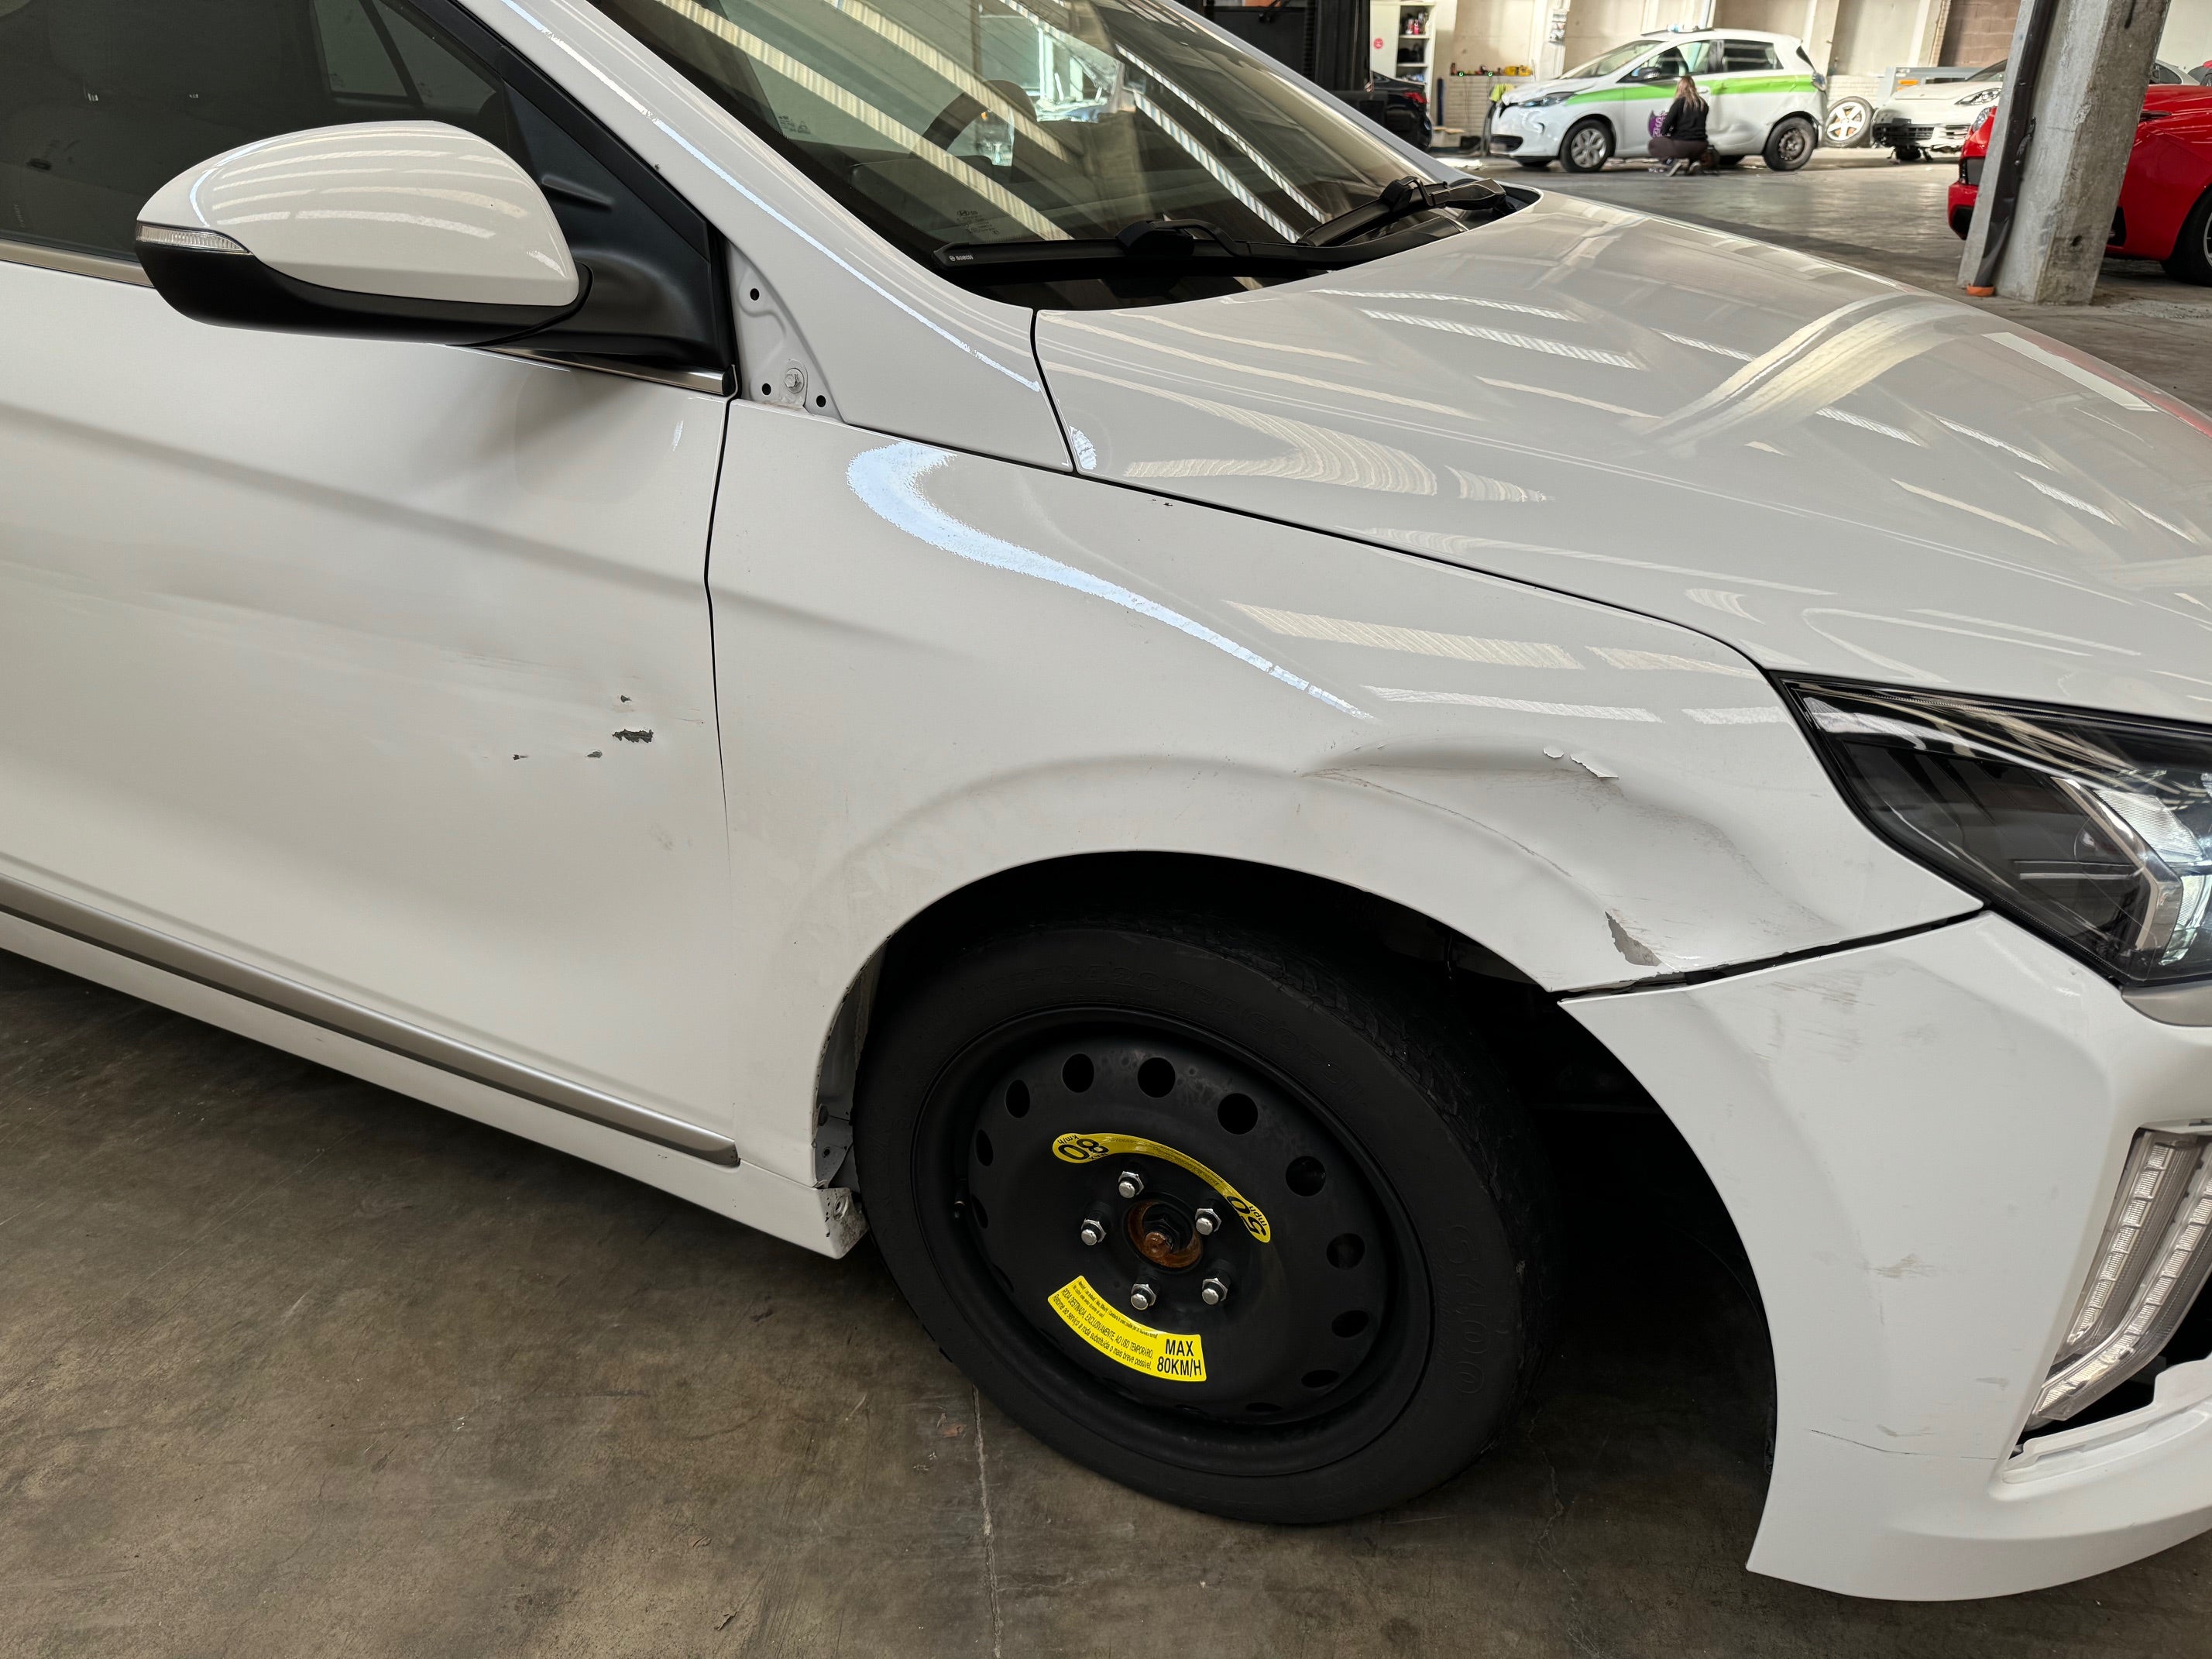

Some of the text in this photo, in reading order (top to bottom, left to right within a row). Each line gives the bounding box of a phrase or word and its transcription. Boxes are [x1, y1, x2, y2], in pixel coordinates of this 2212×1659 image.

[1057, 1134, 1079, 1145] km/h
[1058, 1138, 1109, 1161] 80
[1227, 1196, 1267, 1236] 50
[1249, 1205, 1268, 1227] mph
[1081, 1326, 1091, 1336] roda
[1113, 1348, 1123, 1357] mais
[1122, 1352, 1134, 1363] breve
[1165, 1338, 1194, 1356] MAX
[1157, 1356, 1202, 1377] 80KM/H
